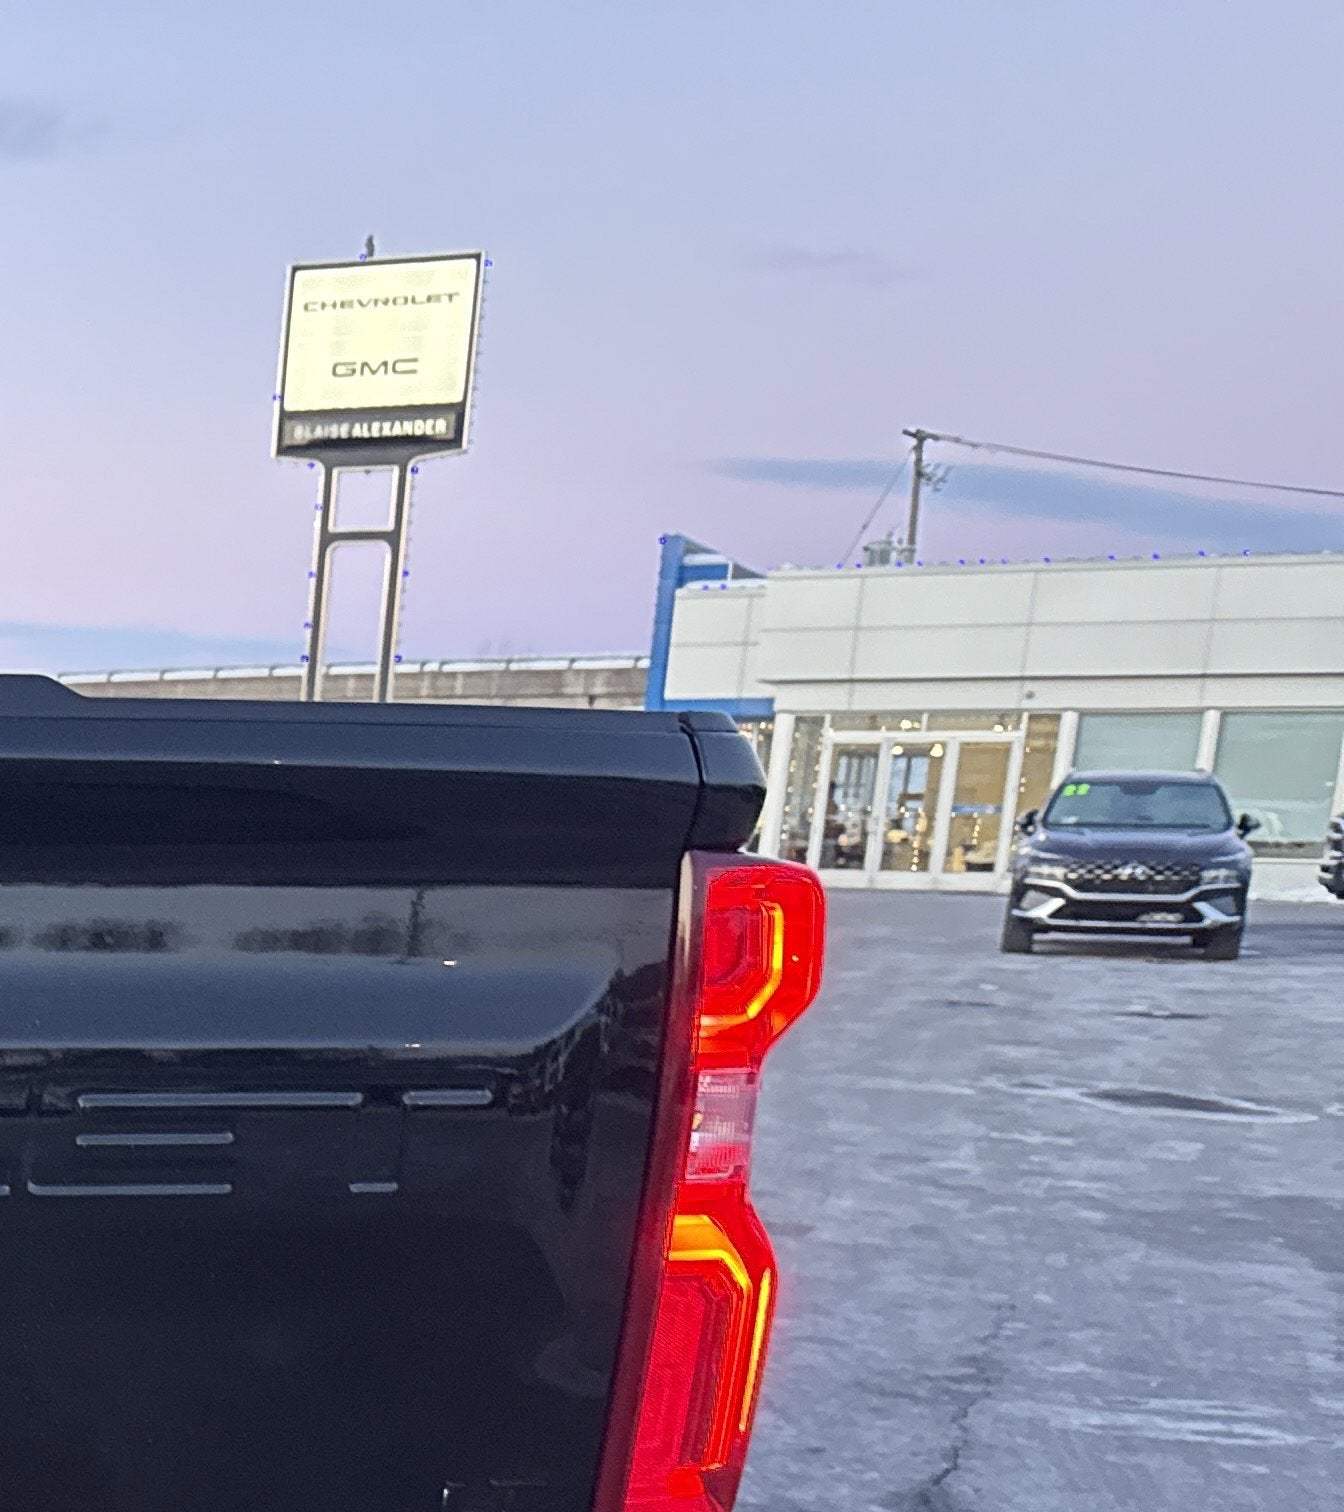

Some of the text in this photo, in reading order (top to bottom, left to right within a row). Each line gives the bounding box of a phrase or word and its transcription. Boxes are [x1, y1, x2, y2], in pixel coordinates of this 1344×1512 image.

[303, 291, 460, 313] CHEVROLET
[331, 357, 420, 378] GMC
[293, 417, 448, 439] BLAISE ALEXANDER
